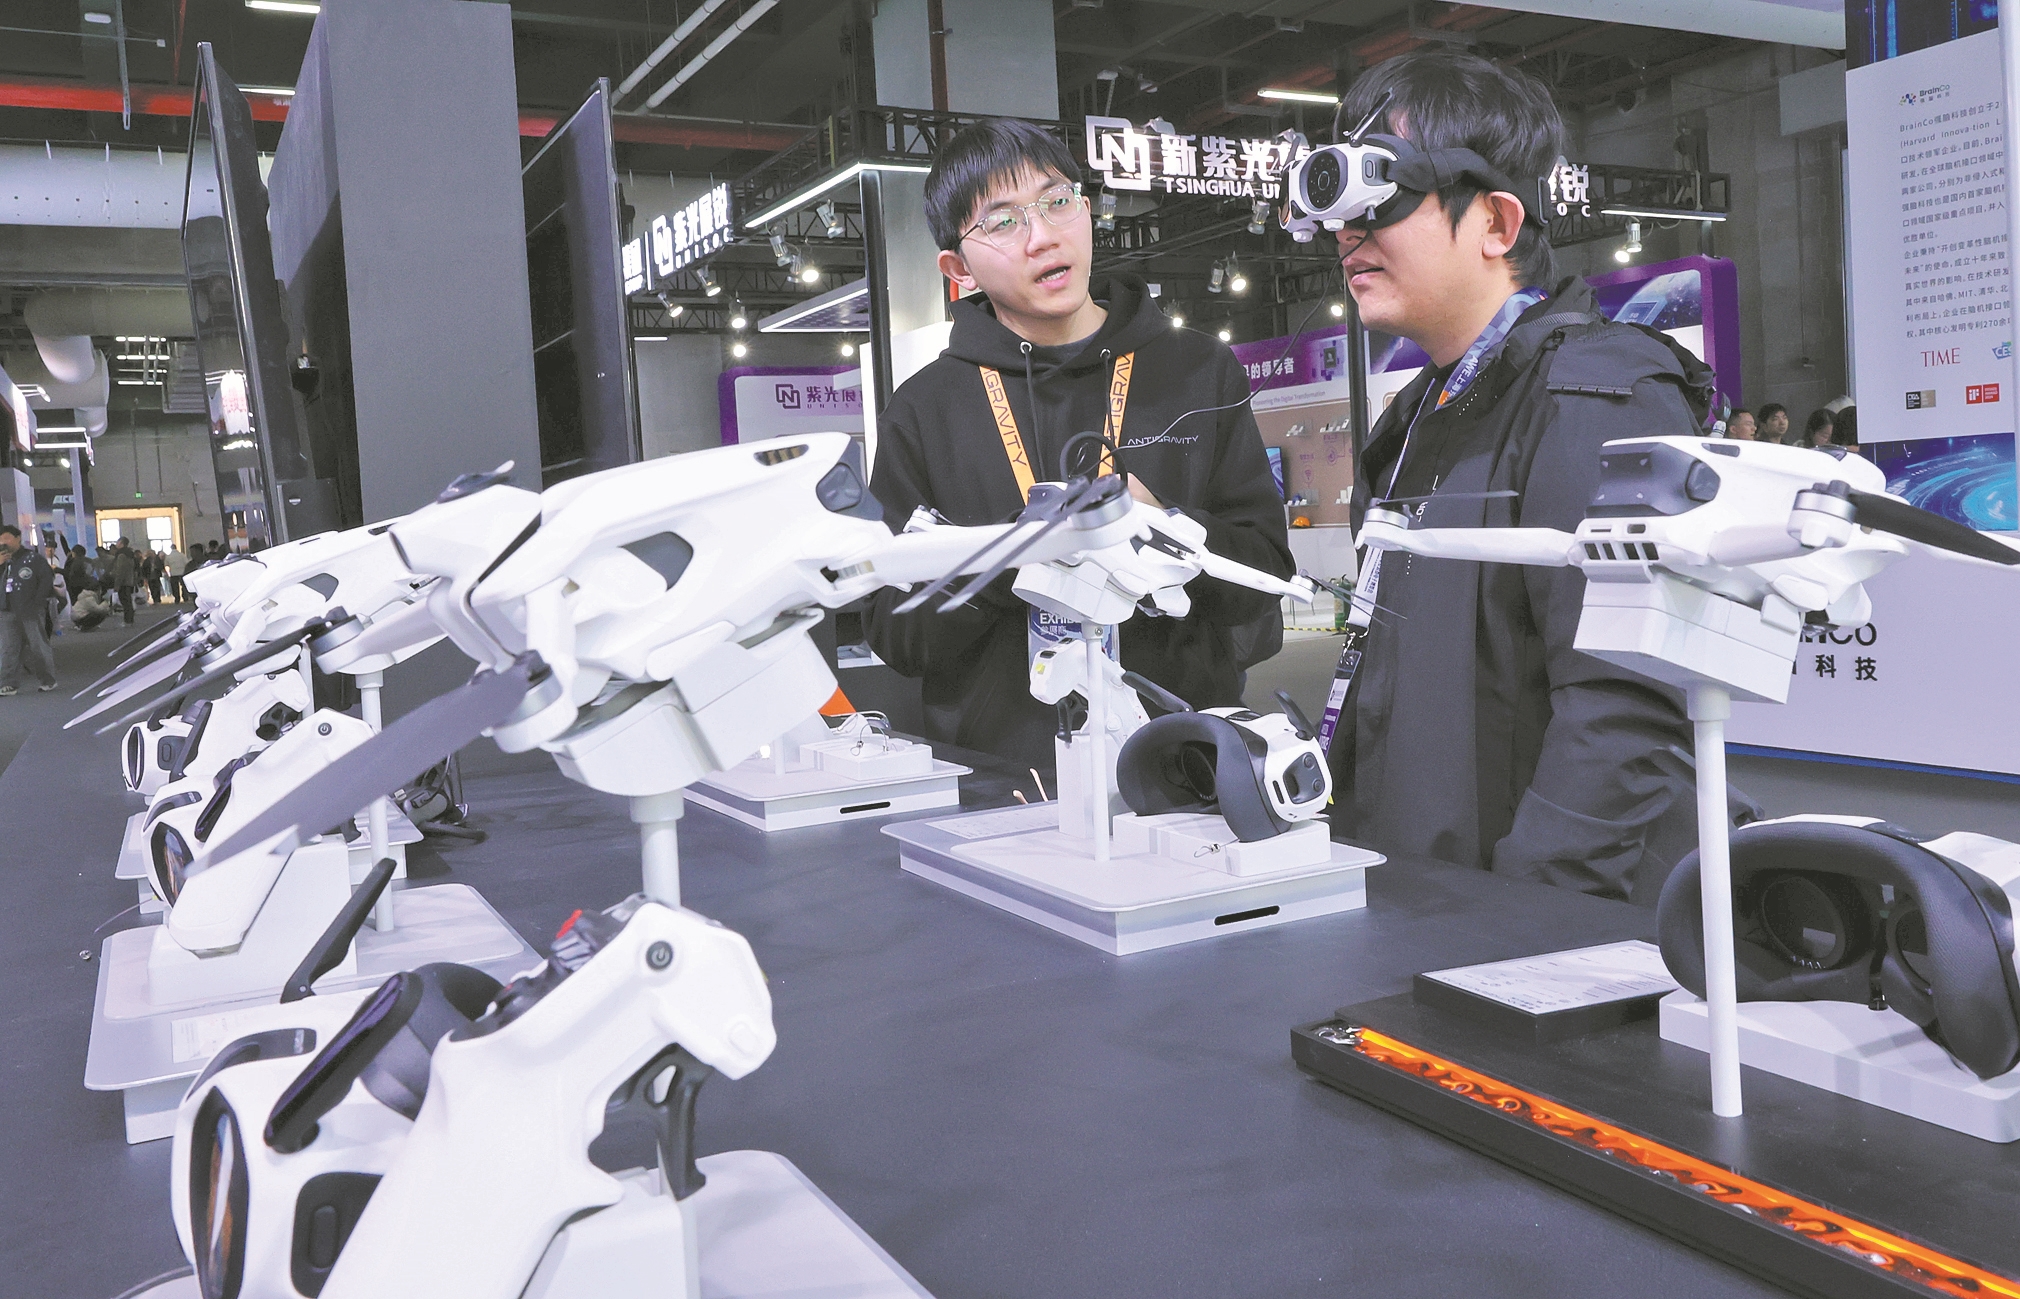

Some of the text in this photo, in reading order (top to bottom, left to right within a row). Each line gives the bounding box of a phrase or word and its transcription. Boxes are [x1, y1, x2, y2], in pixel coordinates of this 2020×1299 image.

[1920, 84, 1950, 97] BrainCo
[1900, 133, 1936, 149] (Harvard
[1163, 176, 1256, 198] TSINGHUA
[1921, 347, 1961, 367] TIME
[806, 386, 863, 403] 紫光展
[1791, 654, 1878, 681] 科技
